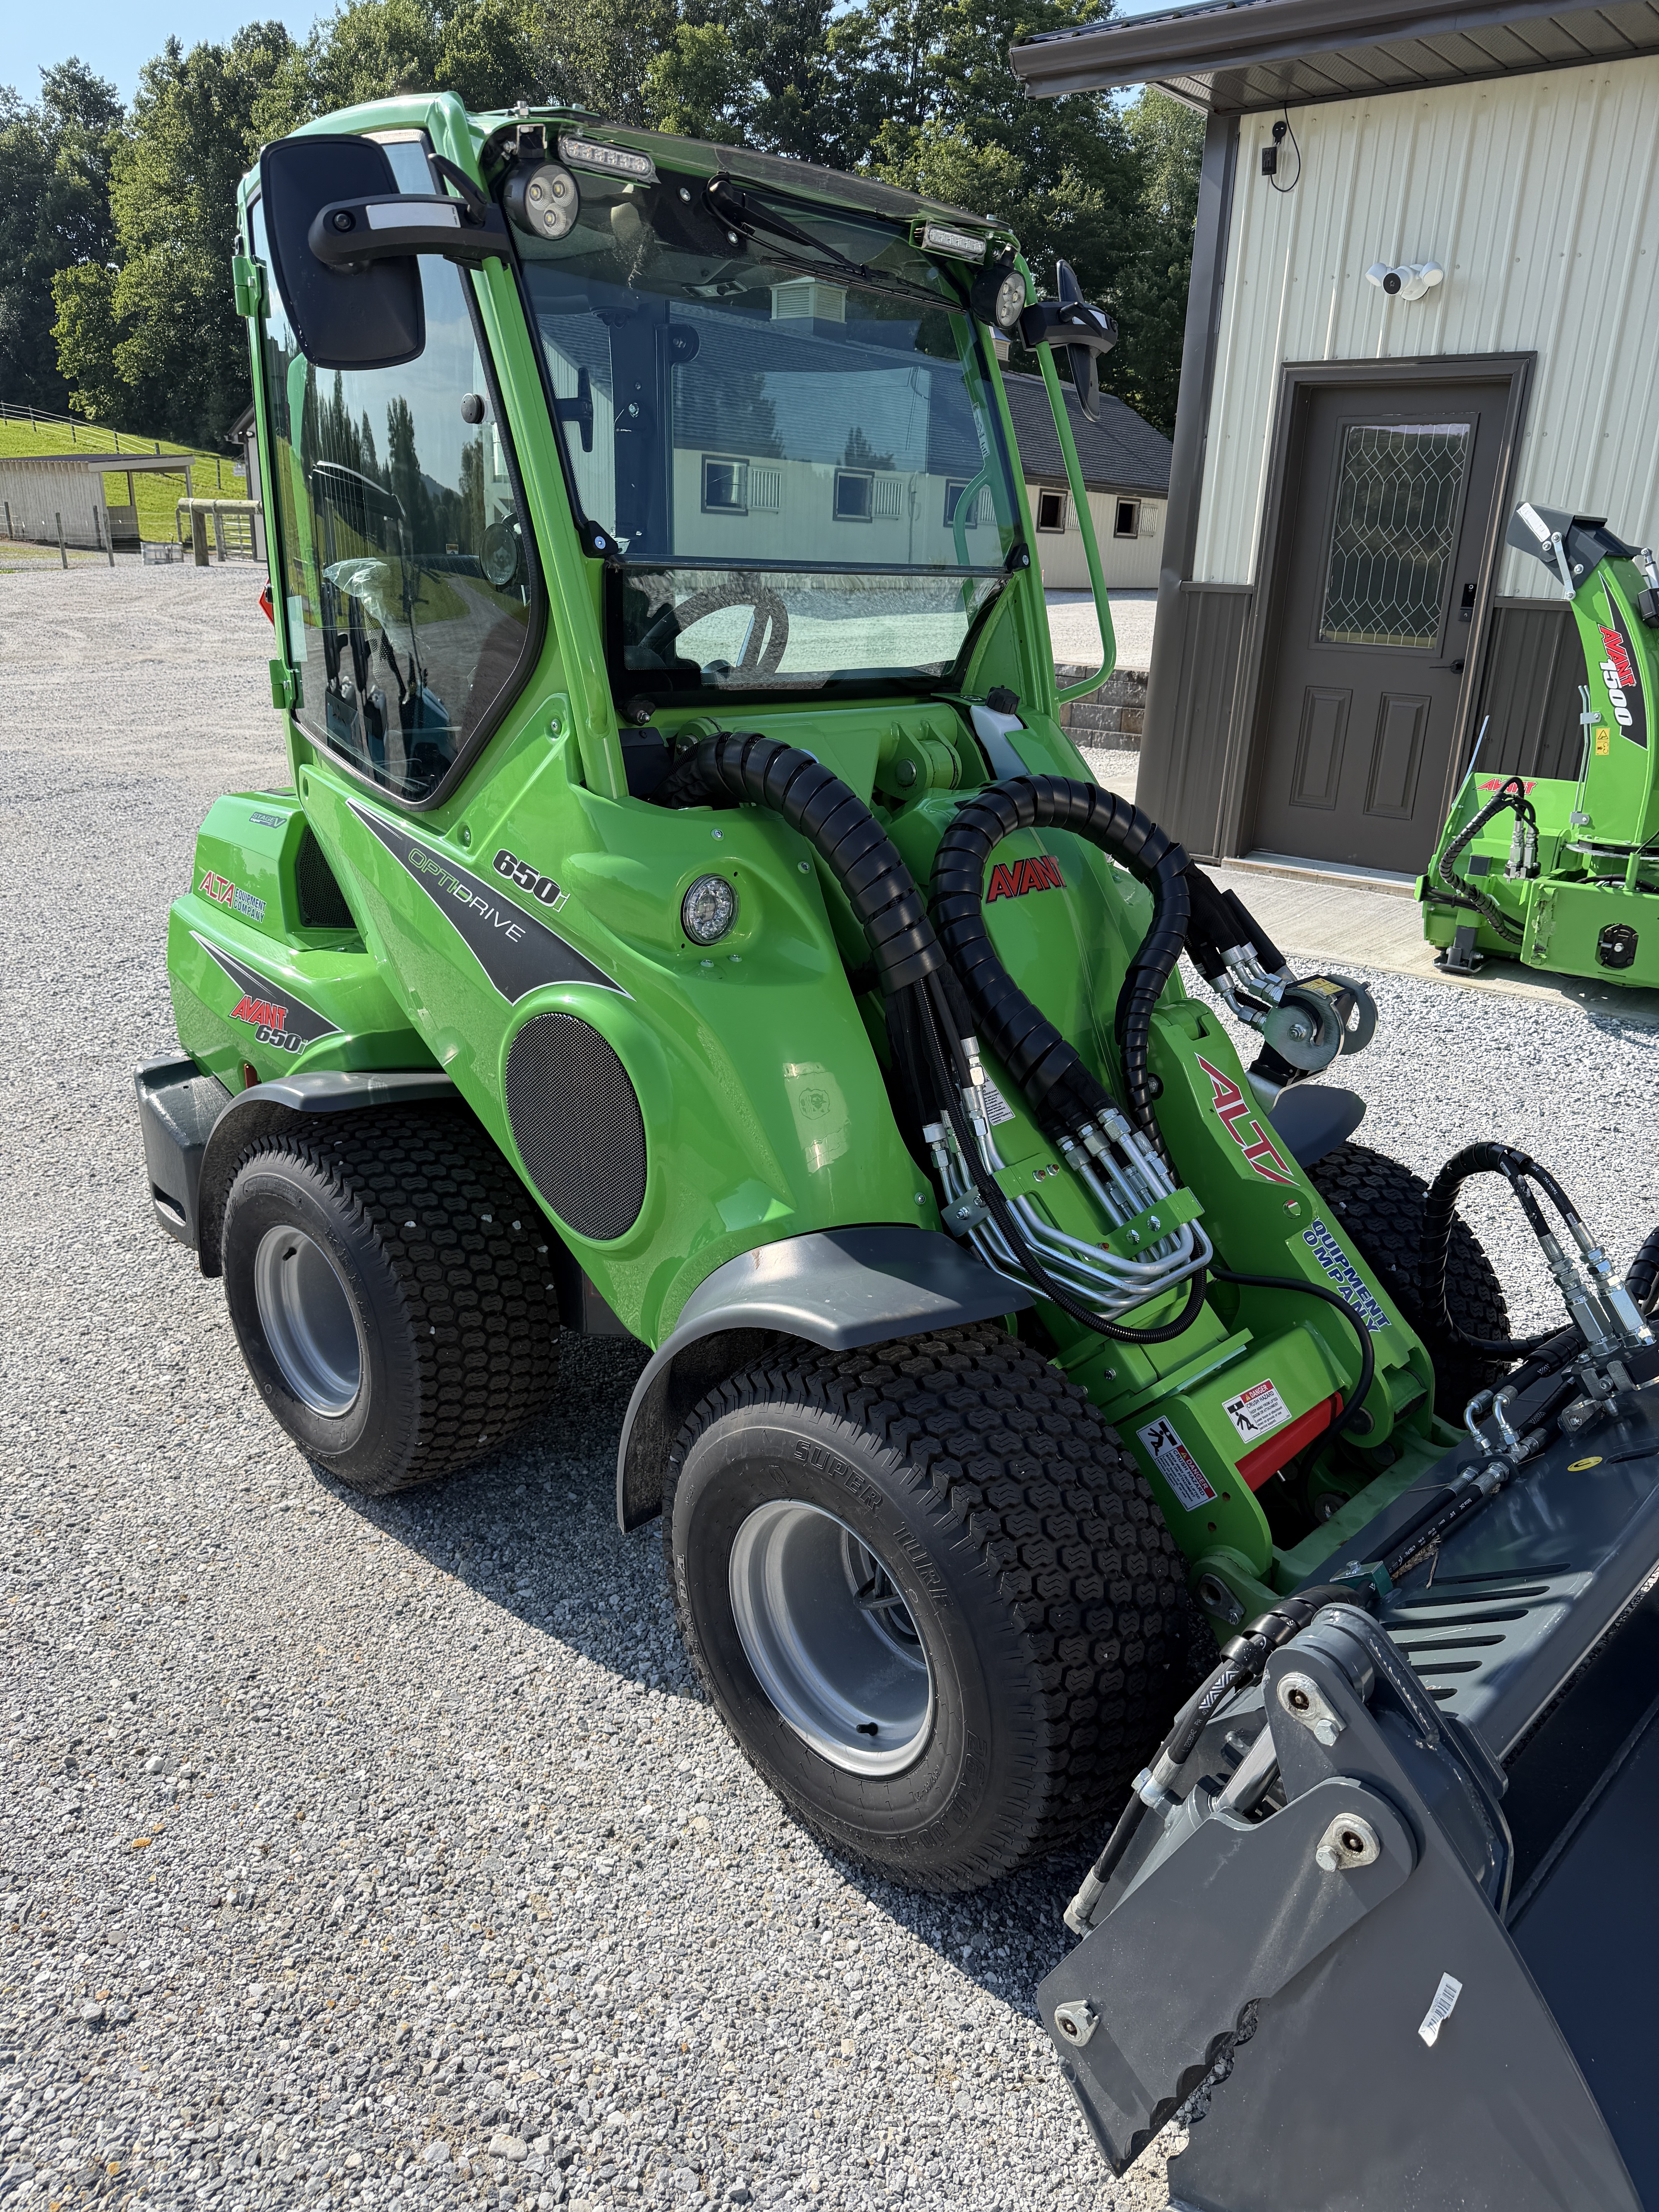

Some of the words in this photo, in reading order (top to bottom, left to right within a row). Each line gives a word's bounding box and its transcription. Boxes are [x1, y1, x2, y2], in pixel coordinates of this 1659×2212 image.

[1598, 623, 1637, 687] AVANT
[1599, 659, 1632, 726] 1500
[252, 813, 275, 823] STAGE
[274, 817, 285, 827] V
[198, 870, 235, 908] ALTA
[235, 887, 266, 912] EQUIPMENT
[409, 848, 526, 943] OPTIDRIVE
[493, 848, 570, 912] 650i
[985, 855, 1067, 905] AVANT
[234, 899, 265, 924] COMPANY
[228, 994, 287, 1030] AVANT
[256, 1024, 308, 1055] 650i
[324, 1223, 374, 1341] KENDA
[1311, 1216, 1392, 1327] QUIPMENT
[1246, 1398, 1259, 1408] CRUSH
[1259, 1391, 1274, 1401] HAZARD
[1249, 1384, 1268, 1398] DANGER
[1263, 1402, 1278, 1412] ATTACHMENT
[794, 1440, 883, 1512] SUPER
[1166, 1454, 1174, 1465] BOOM
[1178, 1473, 1195, 1497] ATTACHMENT
[1173, 1450, 1188, 1470] CRUSH
[1187, 1472, 1204, 1496] HAZARD
[1183, 1474, 1191, 1485] FROM
[1191, 1486, 1200, 1499] LIFTED
[1186, 1459, 1208, 1489] DANGER
[893, 1522, 954, 1607] TURF
